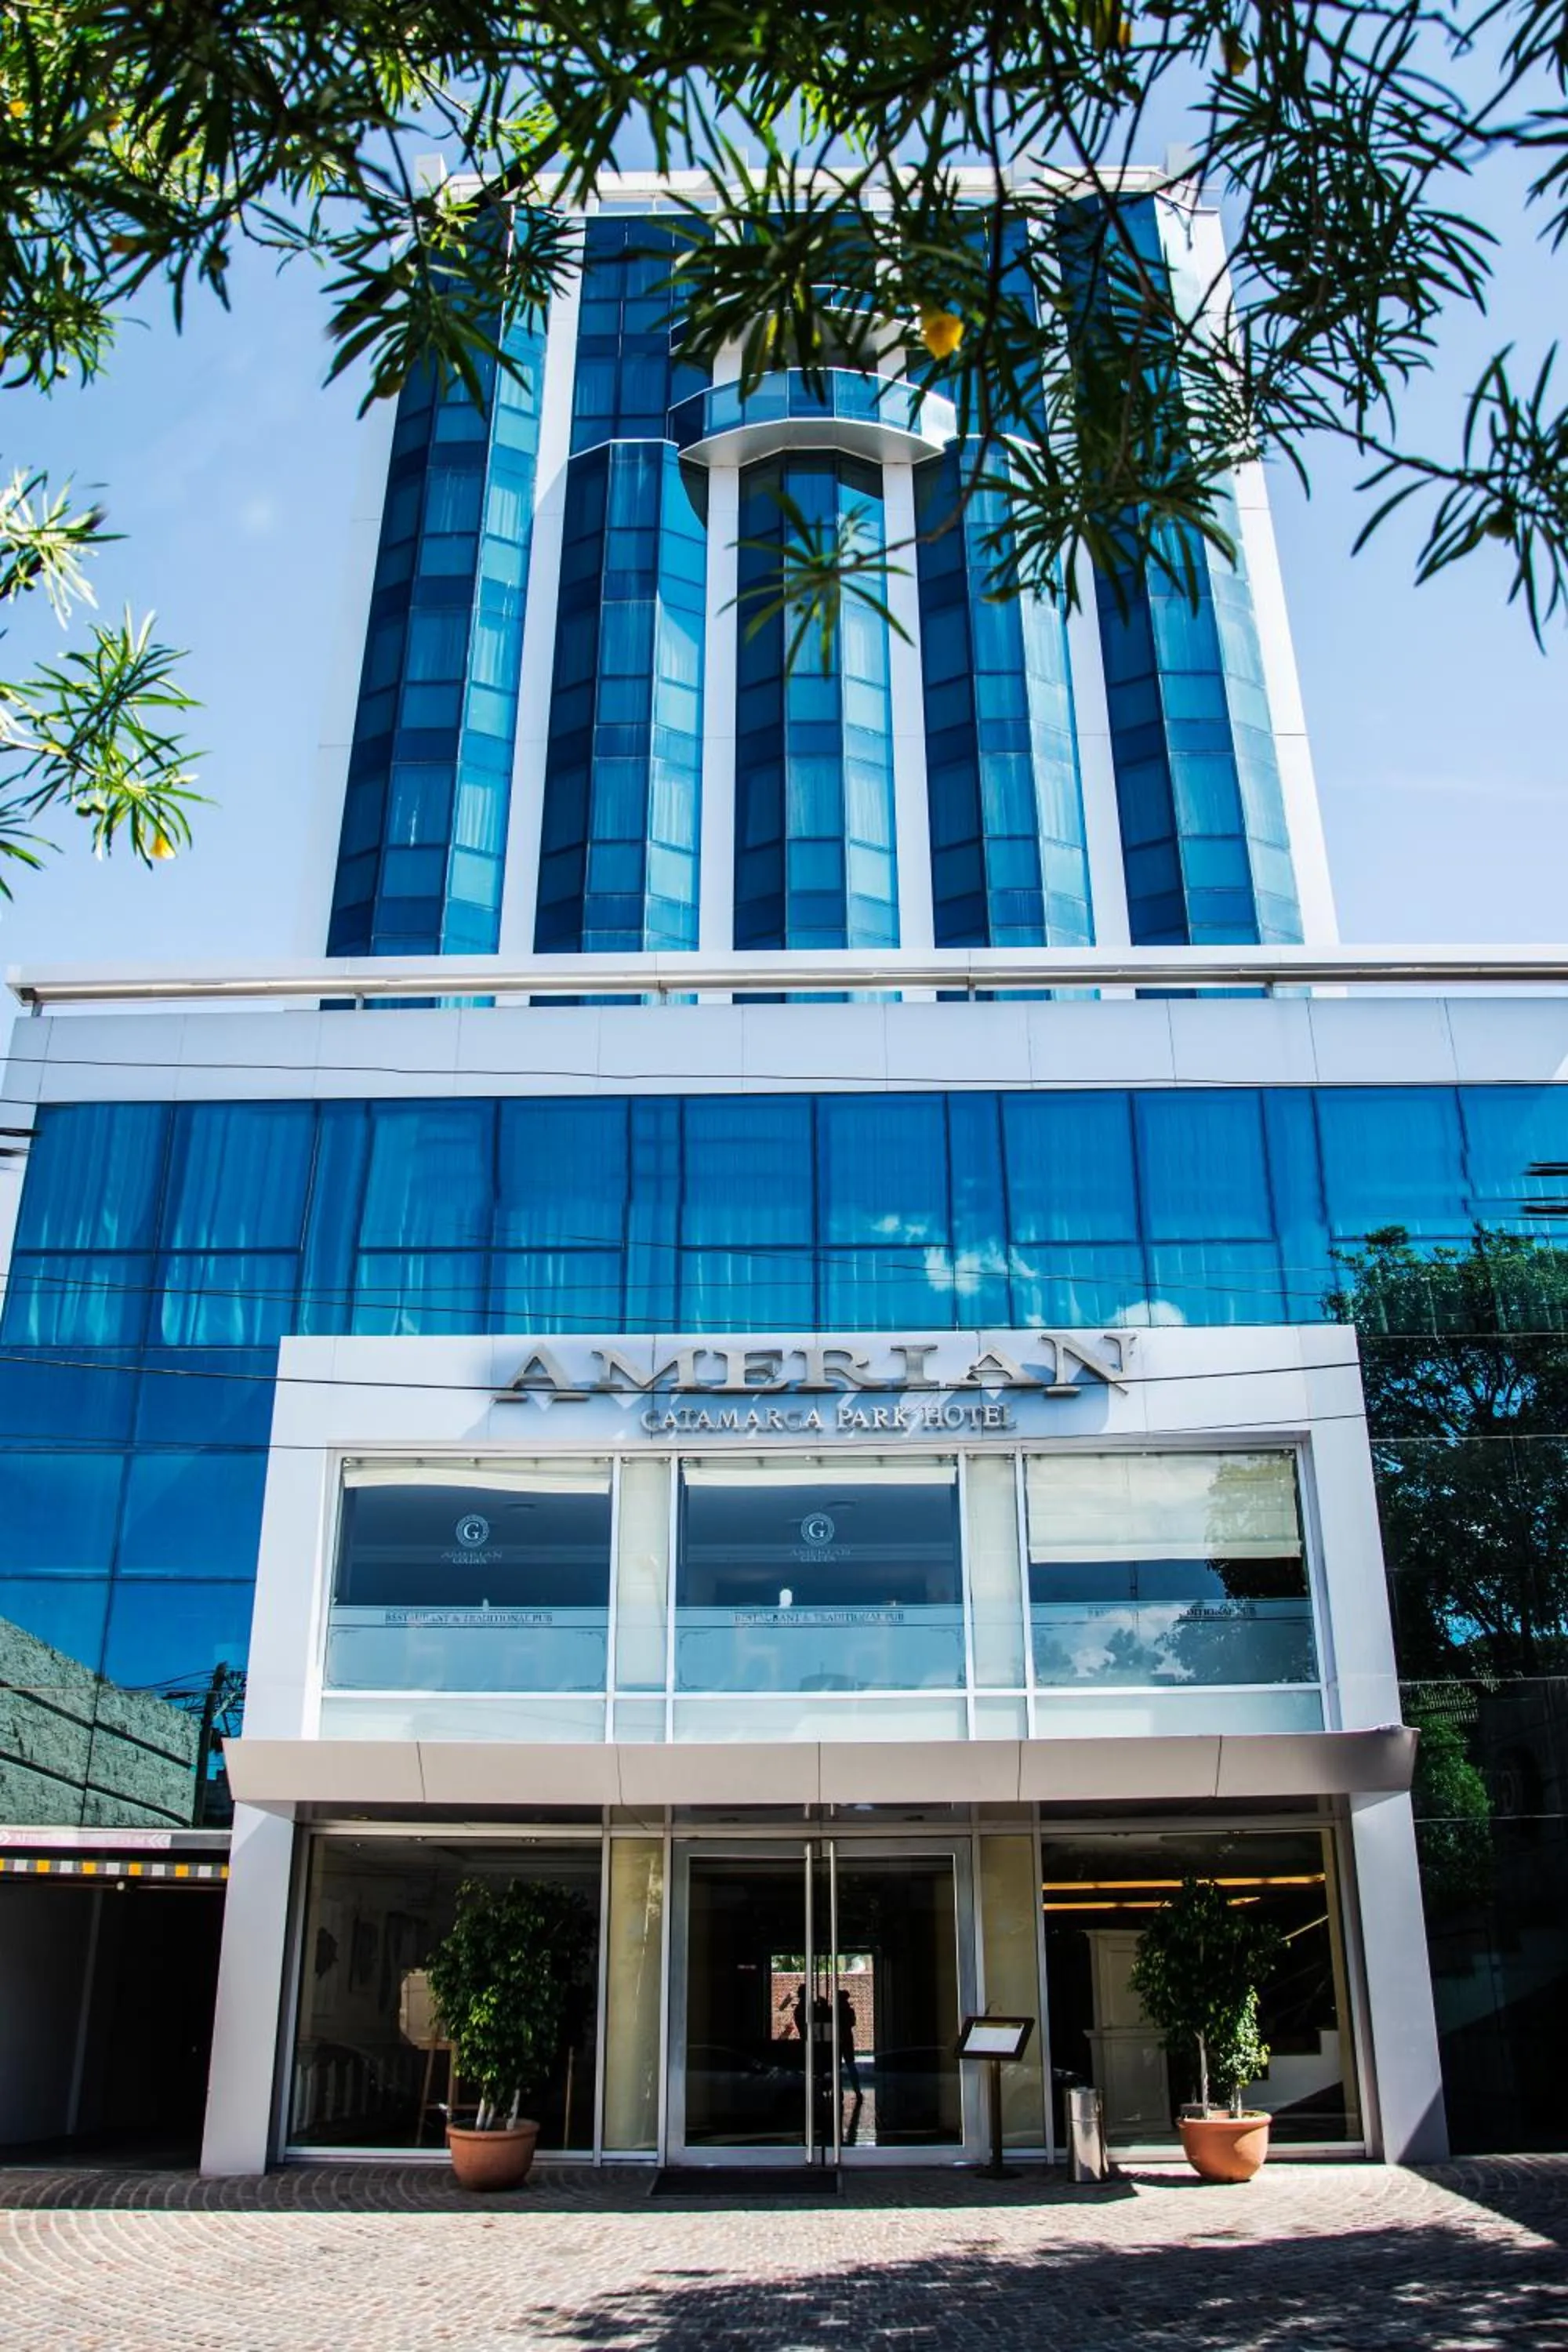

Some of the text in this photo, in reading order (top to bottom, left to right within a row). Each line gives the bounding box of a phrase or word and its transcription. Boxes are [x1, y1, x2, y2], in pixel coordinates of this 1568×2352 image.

[490, 1333, 1138, 1402] AMERIAN
[641, 1403, 1016, 1432] CATAMARCA PARK HOTEL
[463, 1522, 480, 1541] G
[808, 1520, 826, 1539] G
